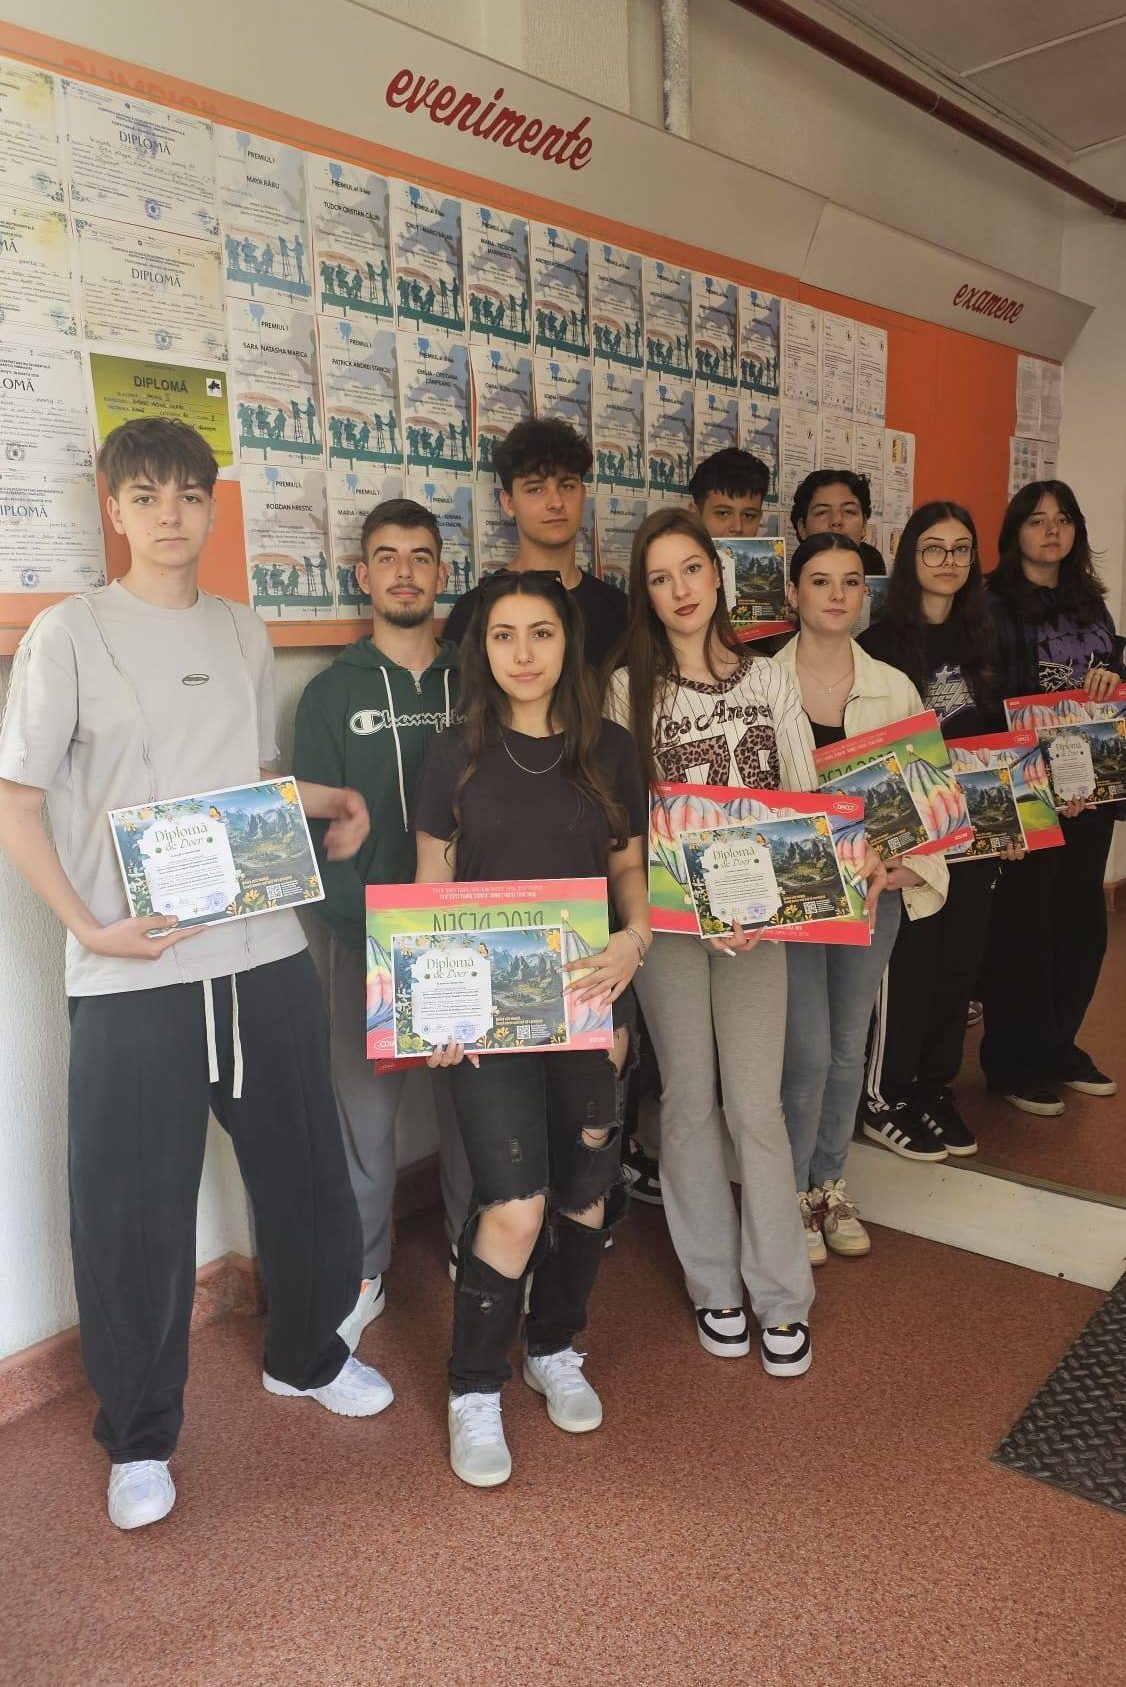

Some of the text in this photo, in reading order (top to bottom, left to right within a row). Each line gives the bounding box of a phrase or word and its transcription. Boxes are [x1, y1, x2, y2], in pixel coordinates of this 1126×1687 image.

[385, 69, 593, 170] evenimente
[119, 130, 171, 156] DIPLOMĂ
[131, 267, 181, 288] DIPLOMĂ
[952, 283, 1024, 324] examene
[261, 321, 286, 331] PREMIUL
[133, 375, 189, 393] DIPLOMĂ
